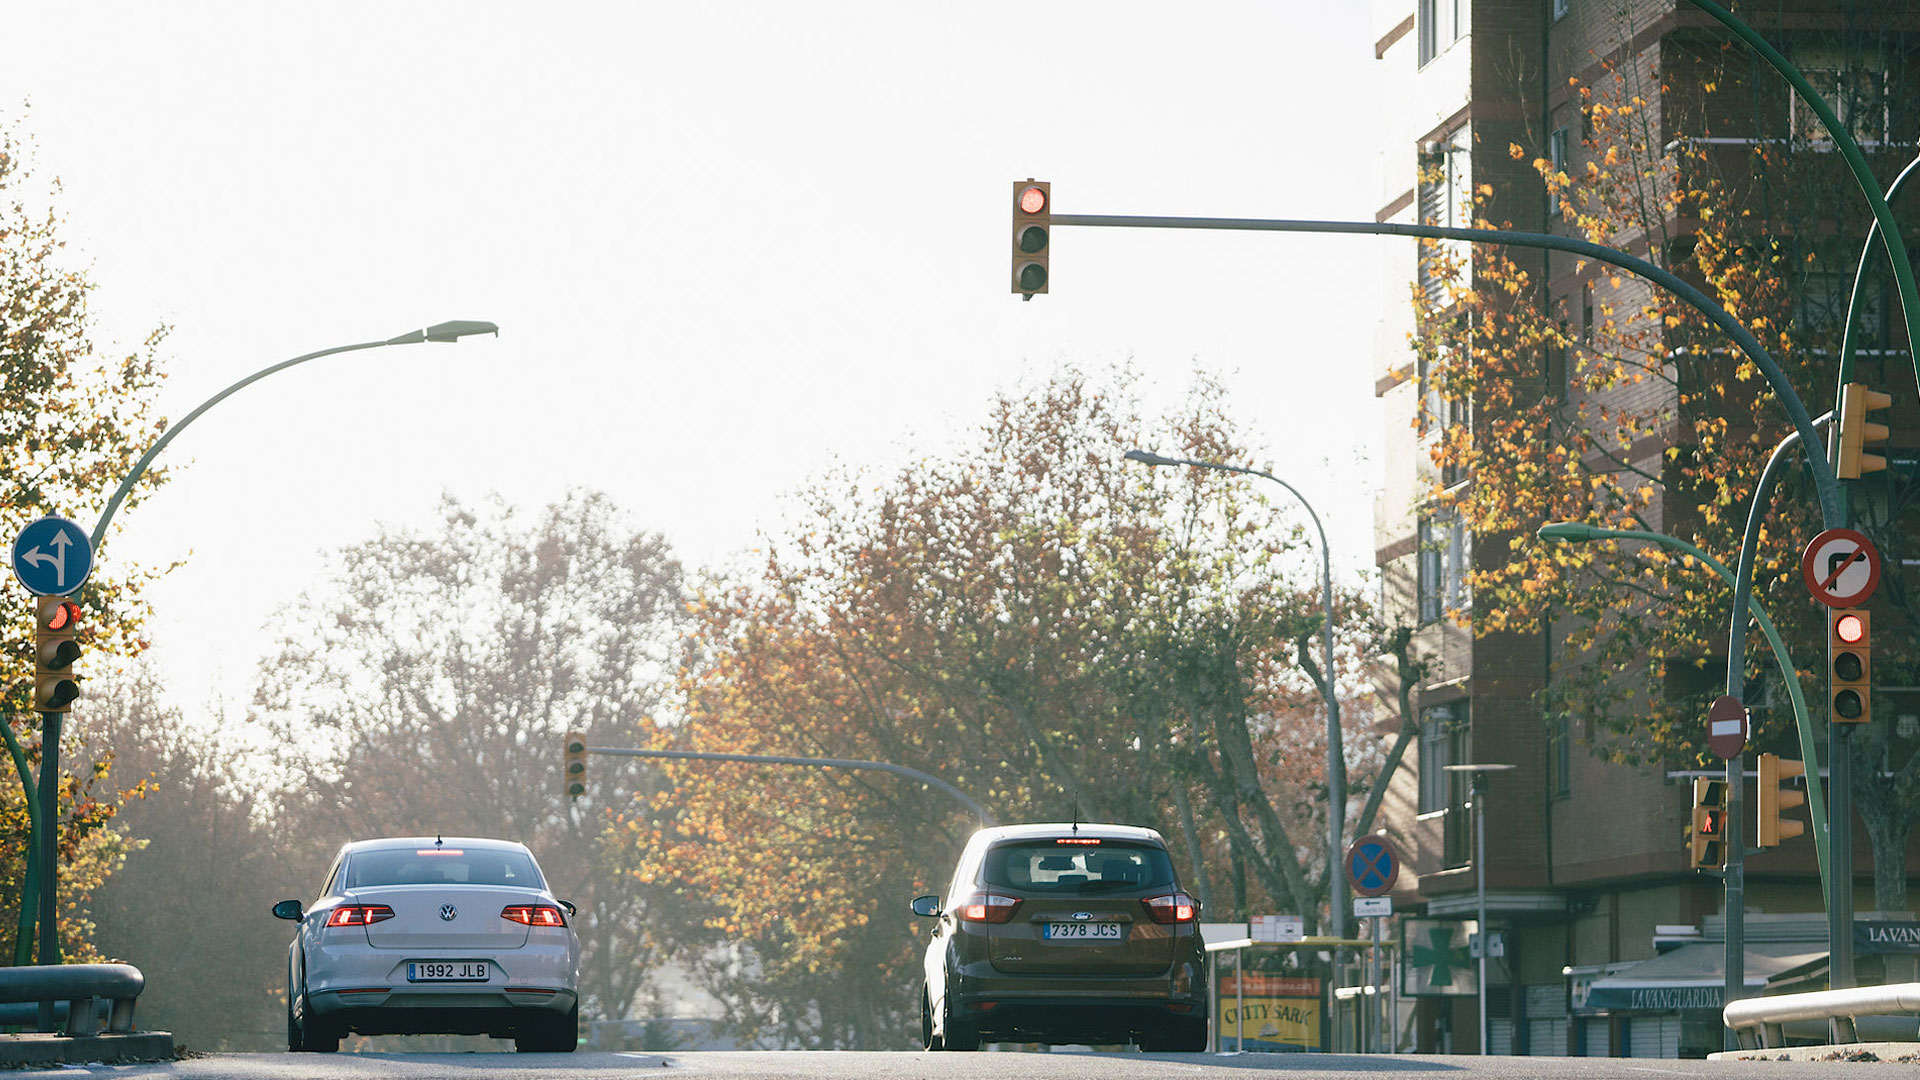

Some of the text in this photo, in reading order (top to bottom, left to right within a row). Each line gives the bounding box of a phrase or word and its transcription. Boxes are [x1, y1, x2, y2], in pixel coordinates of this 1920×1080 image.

[1052, 924, 1118, 936] 7378 JCS
[419, 964, 485, 978] 1992 JLB
[1272, 1004, 1312, 1025] SARK
